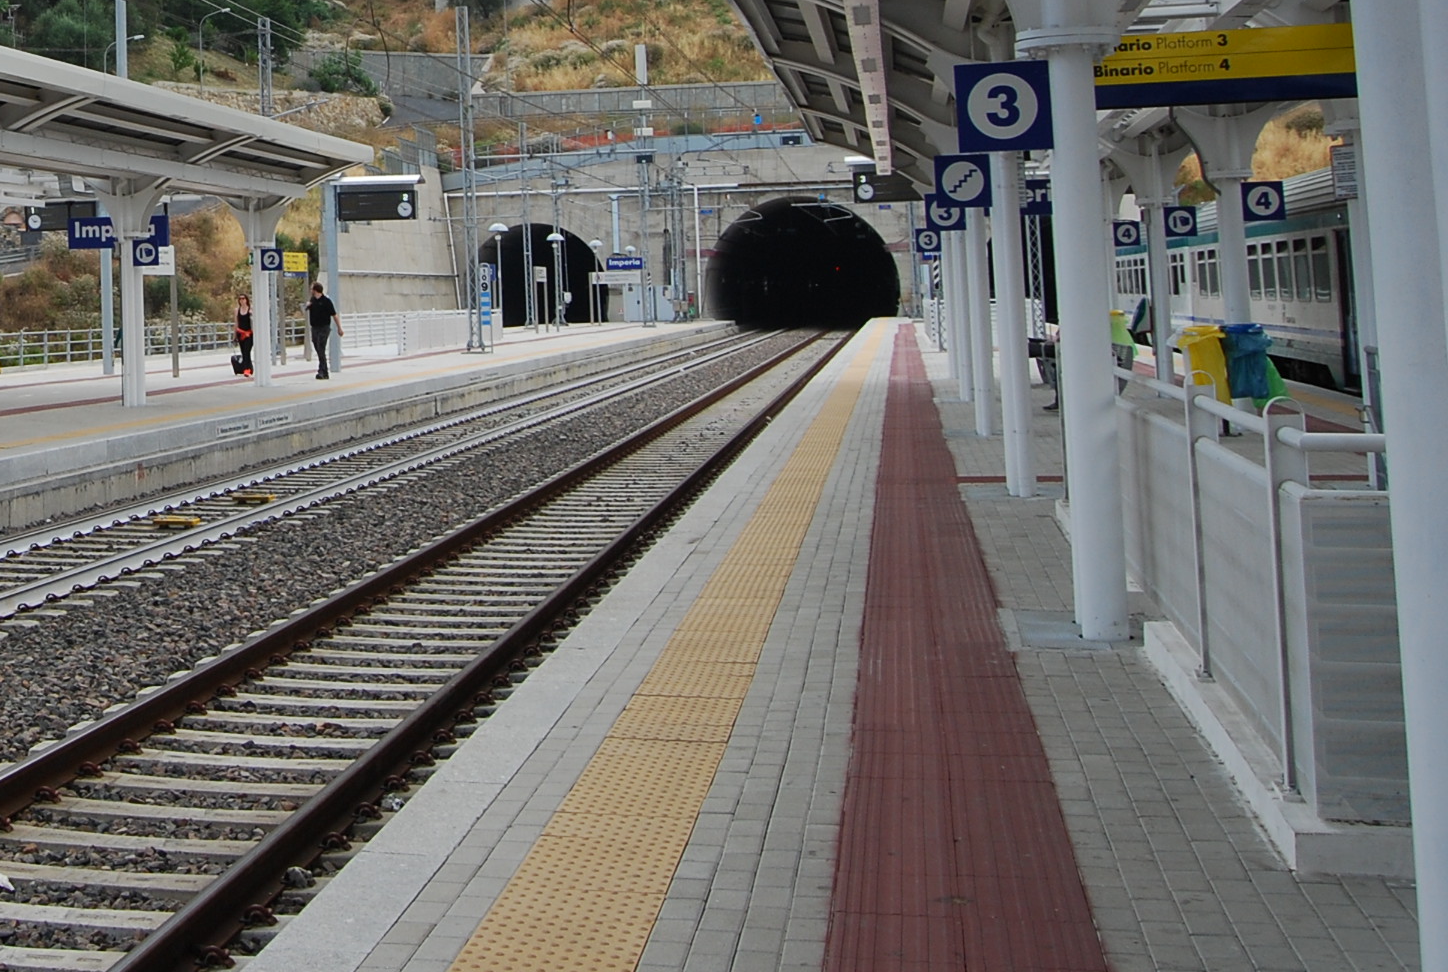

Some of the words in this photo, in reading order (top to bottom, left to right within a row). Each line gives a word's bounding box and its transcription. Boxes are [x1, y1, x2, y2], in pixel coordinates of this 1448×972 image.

[1113, 38, 1152, 52] ario
[1156, 36, 1213, 50] Platform
[1217, 34, 1229, 46] 3
[1093, 63, 1154, 78] Binario
[1158, 61, 1215, 74] Platform
[1219, 58, 1231, 71] 4
[986, 85, 1021, 127] 3
[1255, 191, 1272, 209] 4
[923, 234, 933, 246] 3
[1122, 228, 1132, 239] 4
[267, 254, 276, 266] 2
[608, 259, 641, 268] Imperia
